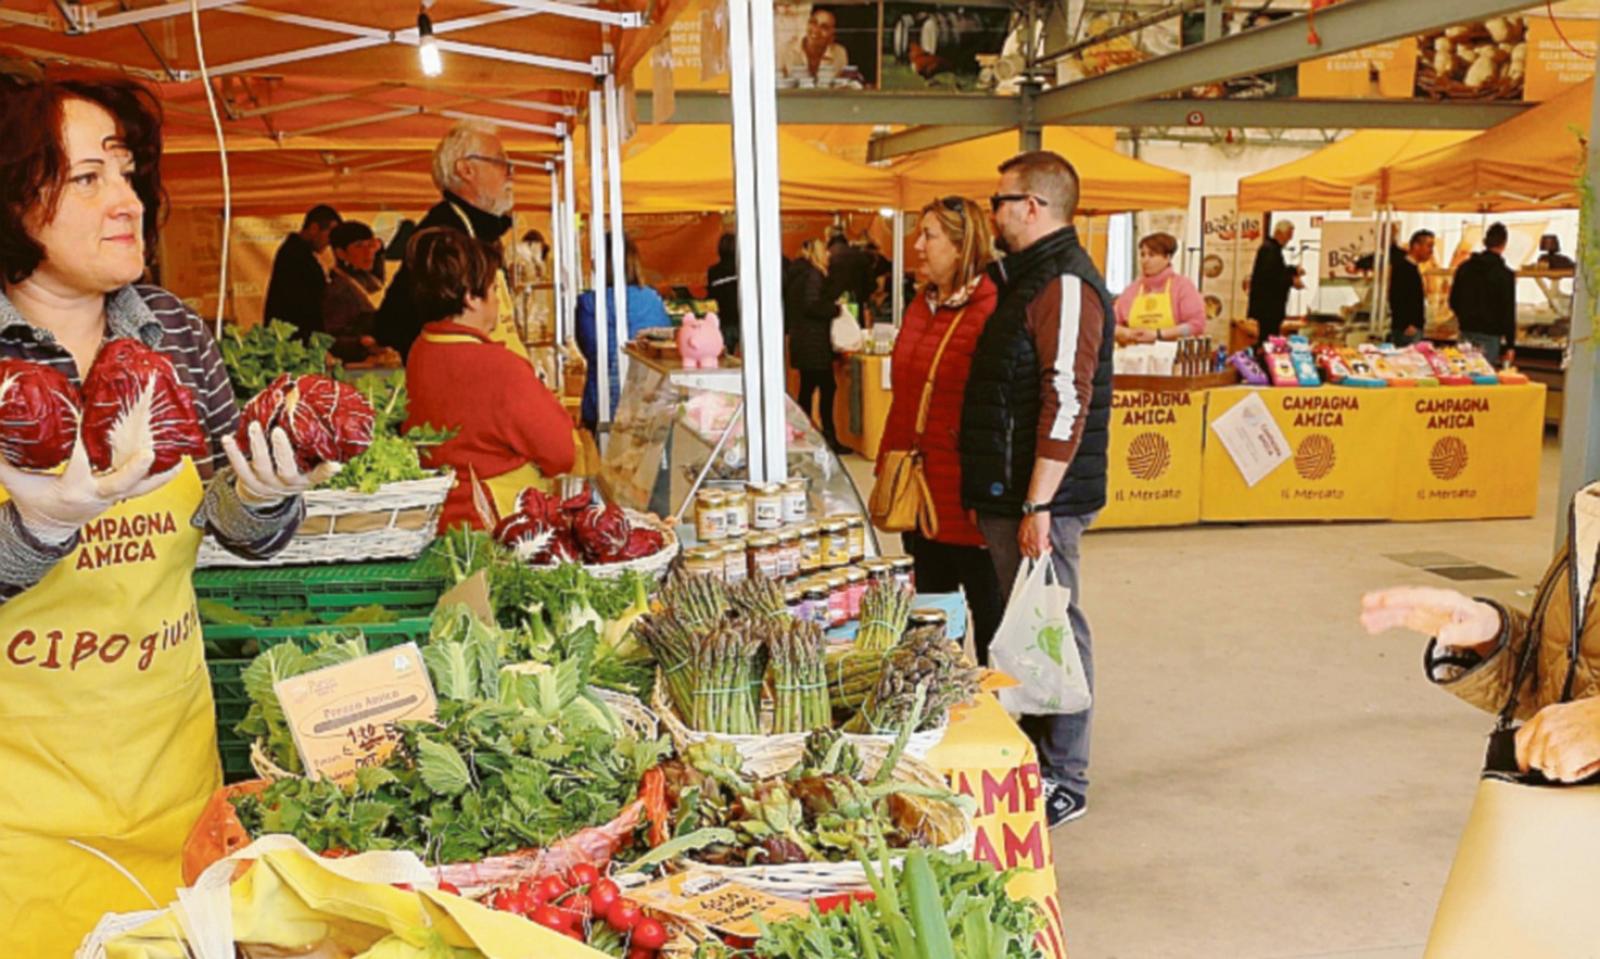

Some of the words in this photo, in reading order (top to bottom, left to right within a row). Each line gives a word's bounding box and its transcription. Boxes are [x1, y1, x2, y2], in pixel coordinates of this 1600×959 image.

[1111, 392, 1191, 408] CAMPAGNA
[1282, 395, 1359, 410] CAMPAGNA
[1415, 397, 1489, 413] CAMPAGNA
[1122, 408, 1176, 425] AMICA
[1293, 413, 1344, 427] AMICA
[1426, 414, 1475, 429] AMICA
[1129, 488, 1182, 501] Mercato
[1293, 488, 1345, 500] Mercato
[1428, 488, 1477, 499] Mercato
[78, 511, 177, 545] MPAGNA
[75, 539, 157, 571] AMICA
[6, 628, 131, 672] CIBO
